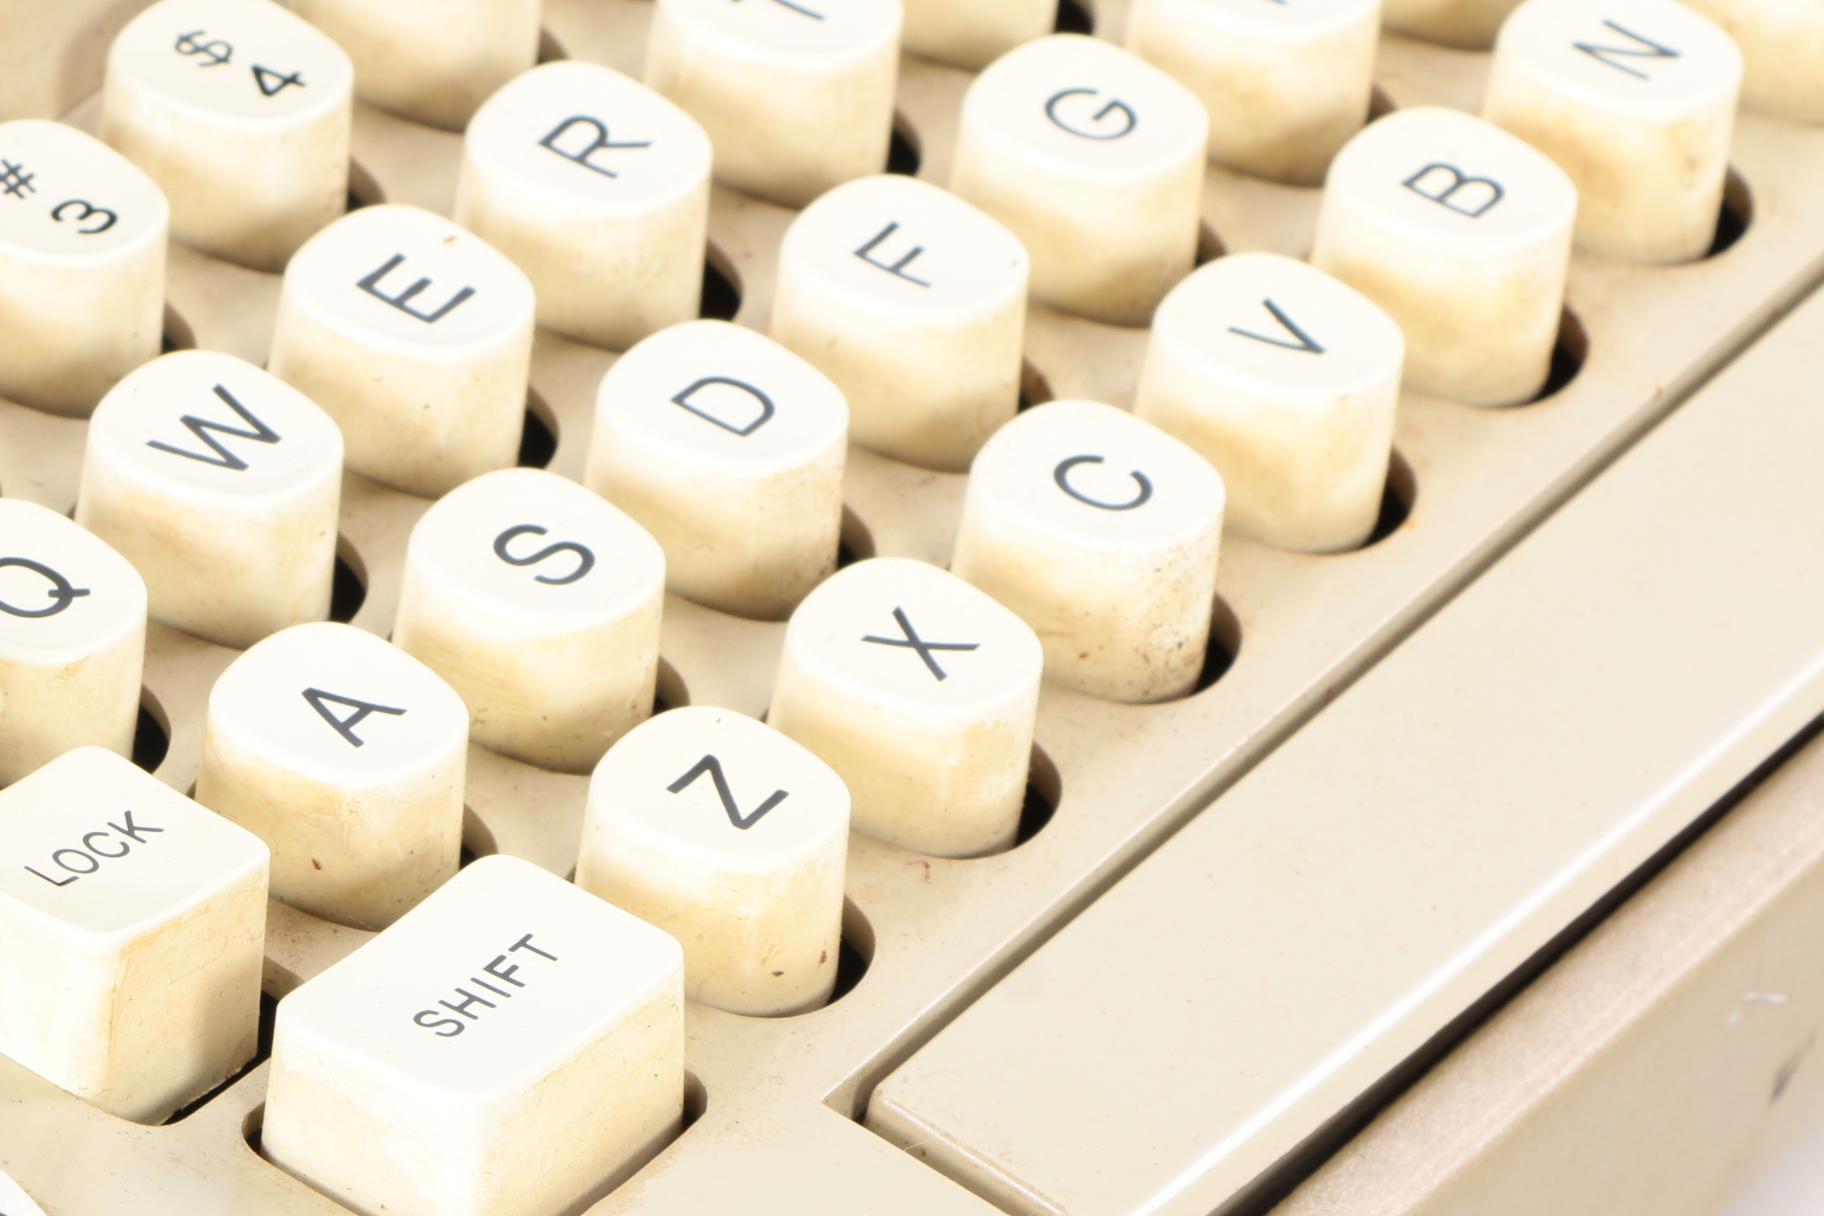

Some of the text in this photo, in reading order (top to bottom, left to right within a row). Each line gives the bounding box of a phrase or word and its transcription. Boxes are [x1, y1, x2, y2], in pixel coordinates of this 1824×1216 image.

[174, 30, 233, 67] $
[1572, 20, 1681, 80] N
[251, 64, 305, 98] 4
[1043, 87, 1138, 141] G
[537, 115, 651, 179] R
[50, 199, 118, 235] 3
[1401, 162, 1505, 219] B
[853, 221, 930, 287] F
[355, 253, 476, 324] E
[1228, 298, 1325, 355] V
[146, 384, 282, 472] W
[670, 376, 775, 438] D
[1053, 454, 1153, 512] C
[492, 524, 596, 586] S
[861, 606, 980, 682] X
[301, 687, 407, 748] A
[666, 754, 789, 831] Z
[23, 810, 165, 888] LOCK
[412, 933, 558, 1038] SHIFT
